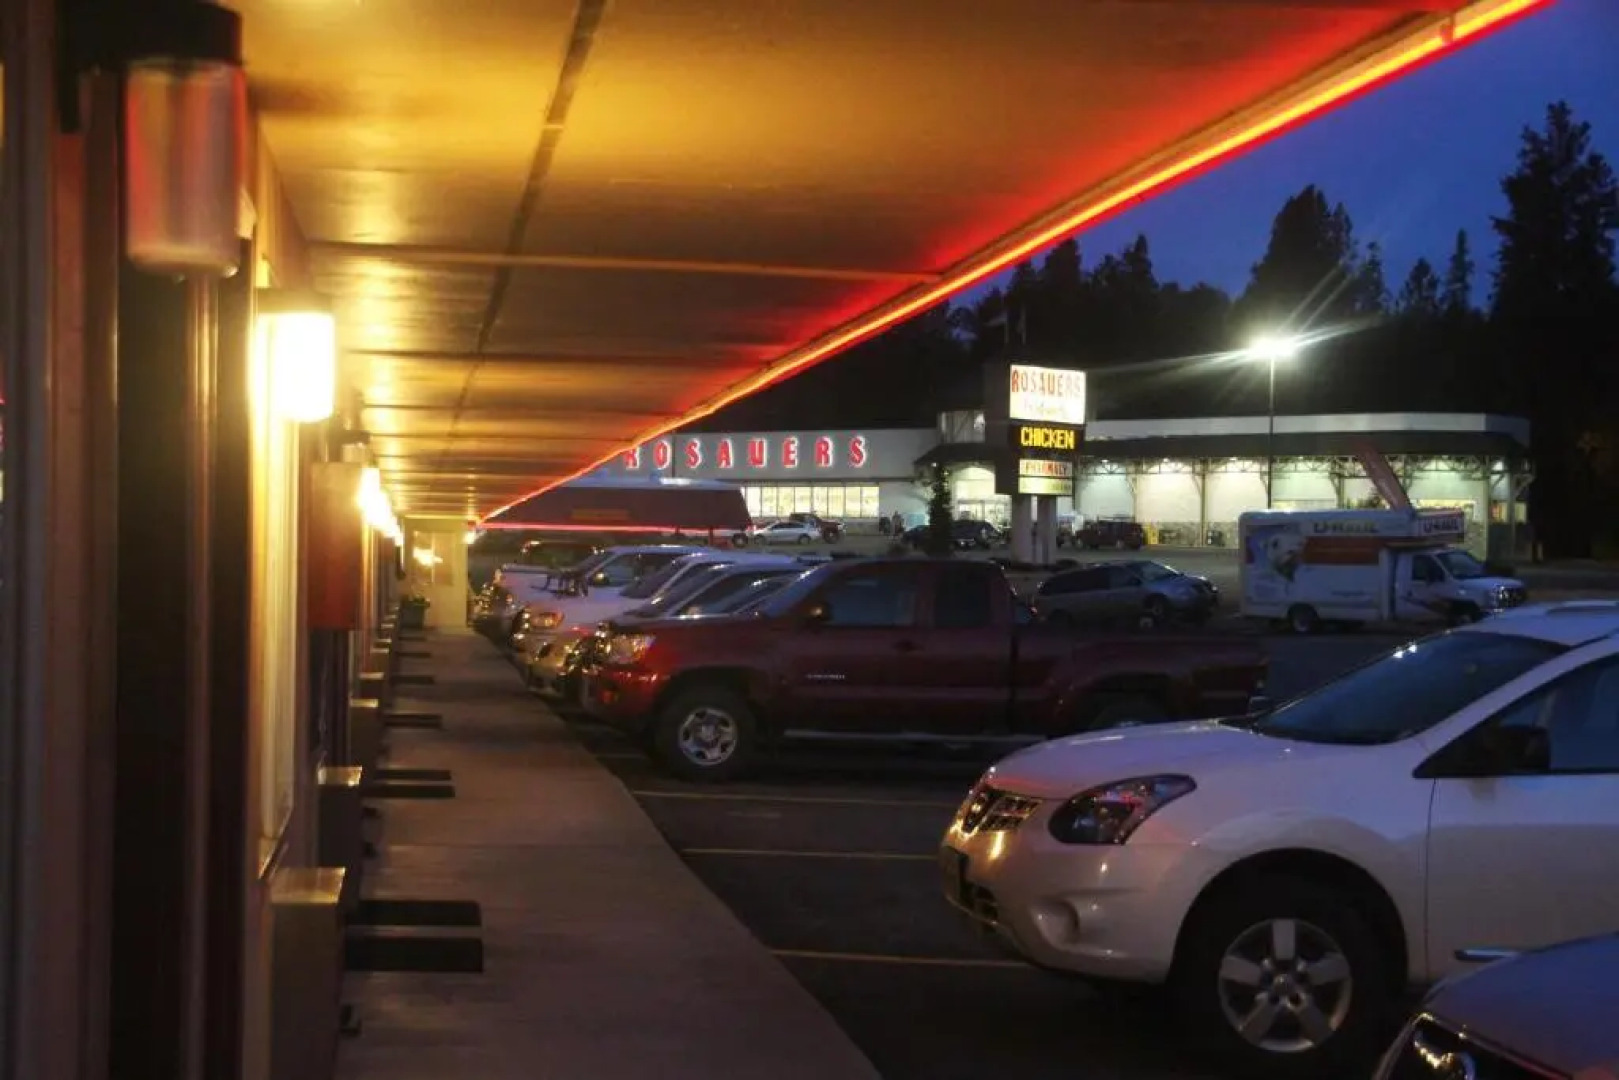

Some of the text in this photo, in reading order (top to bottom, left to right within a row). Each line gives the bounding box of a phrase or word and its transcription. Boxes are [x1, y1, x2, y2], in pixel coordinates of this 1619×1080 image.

[1011, 370, 1081, 398] ROSAUERS
[1020, 426, 1075, 450] CHICKEN
[623, 436, 867, 470] ROSAUERS
